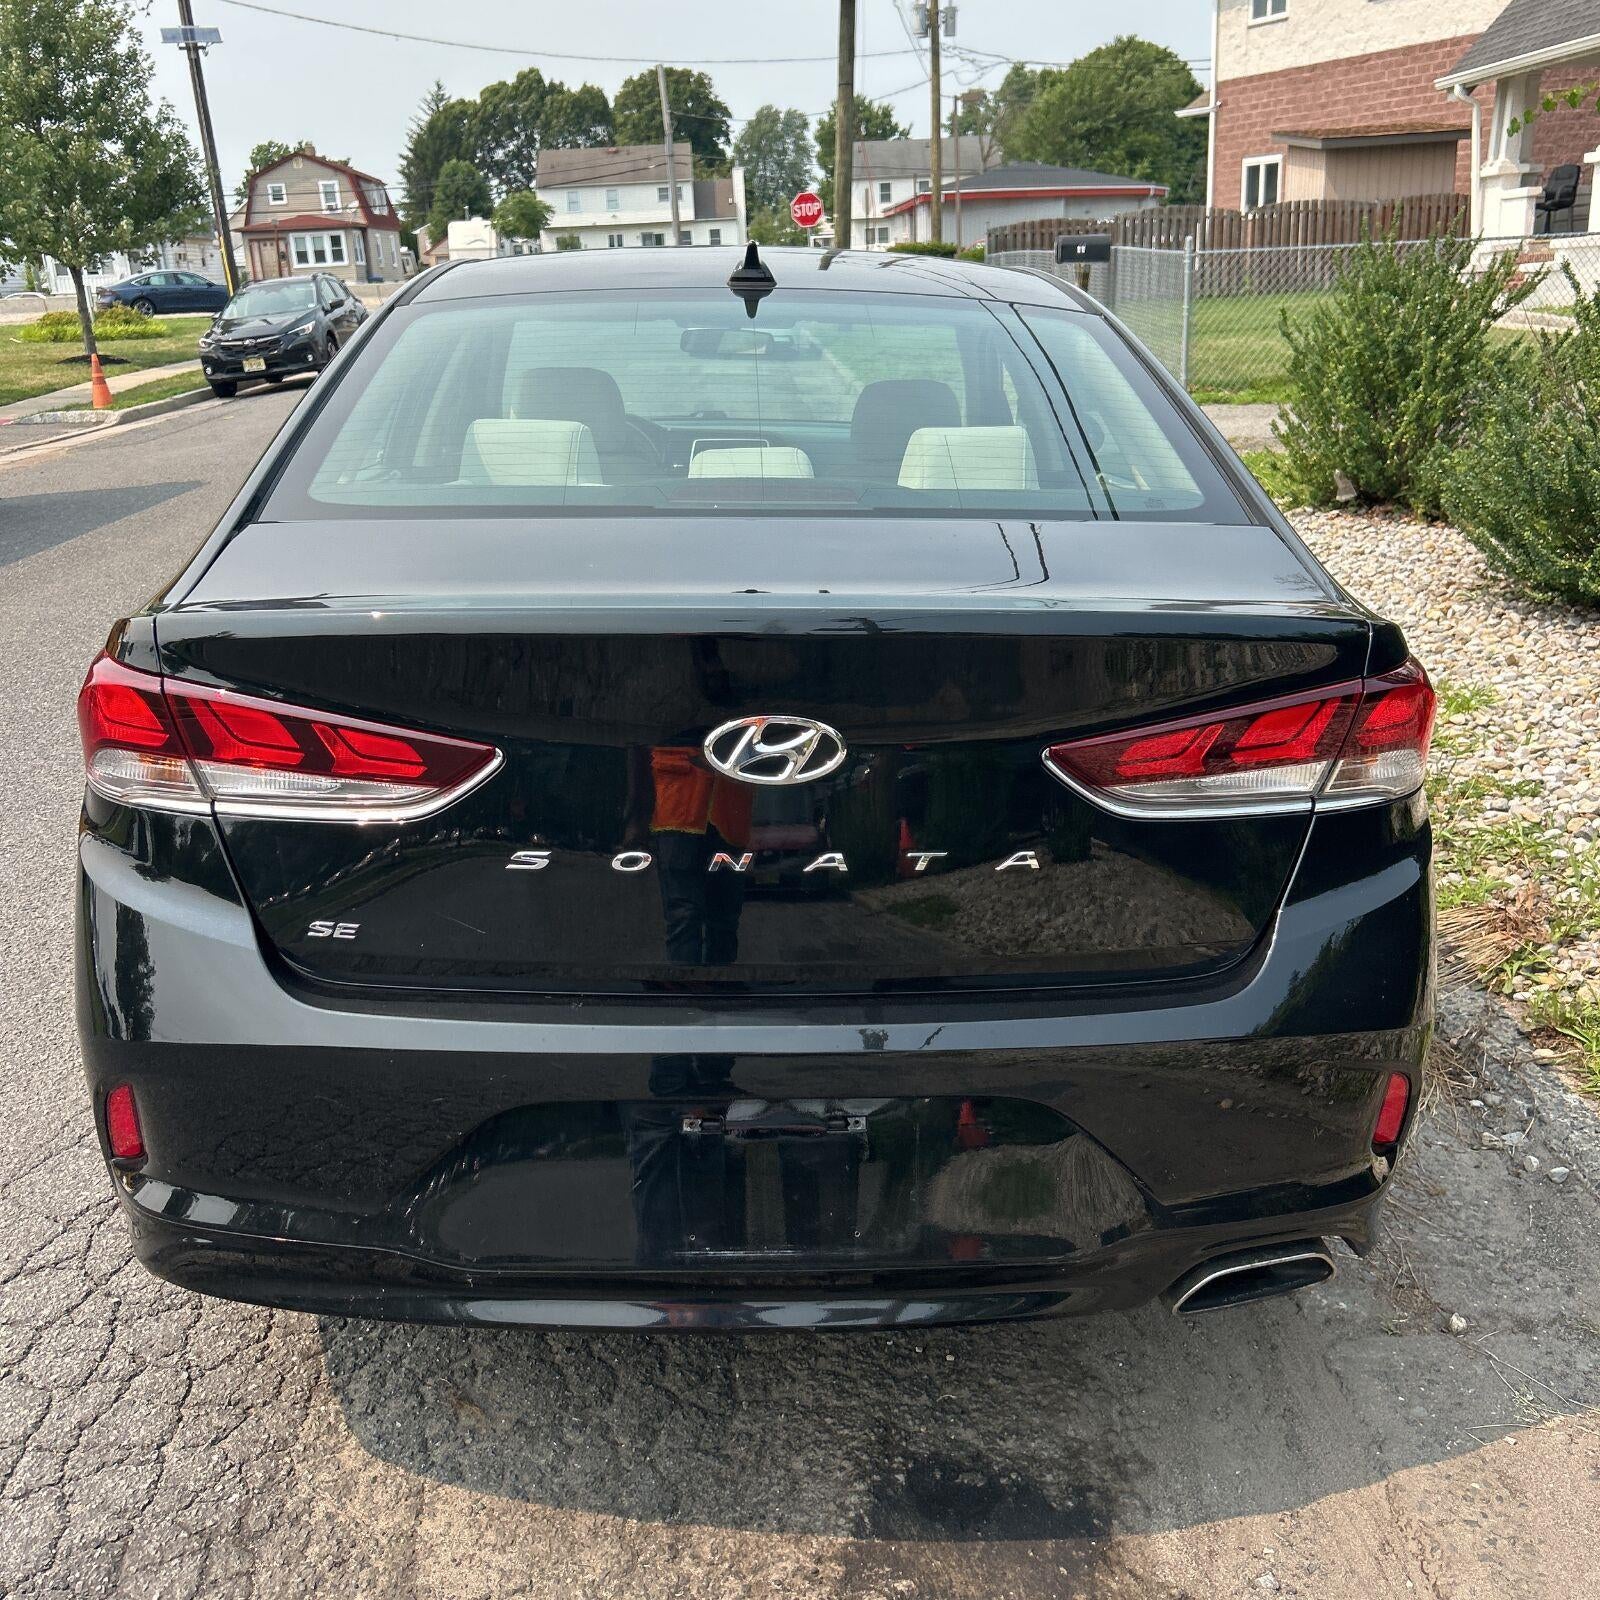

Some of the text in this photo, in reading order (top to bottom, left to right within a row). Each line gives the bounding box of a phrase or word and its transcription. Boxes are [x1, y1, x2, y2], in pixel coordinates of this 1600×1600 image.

[793, 202, 820, 217] STOP
[505, 850, 1040, 872] SONATA
[307, 920, 360, 939] SE
